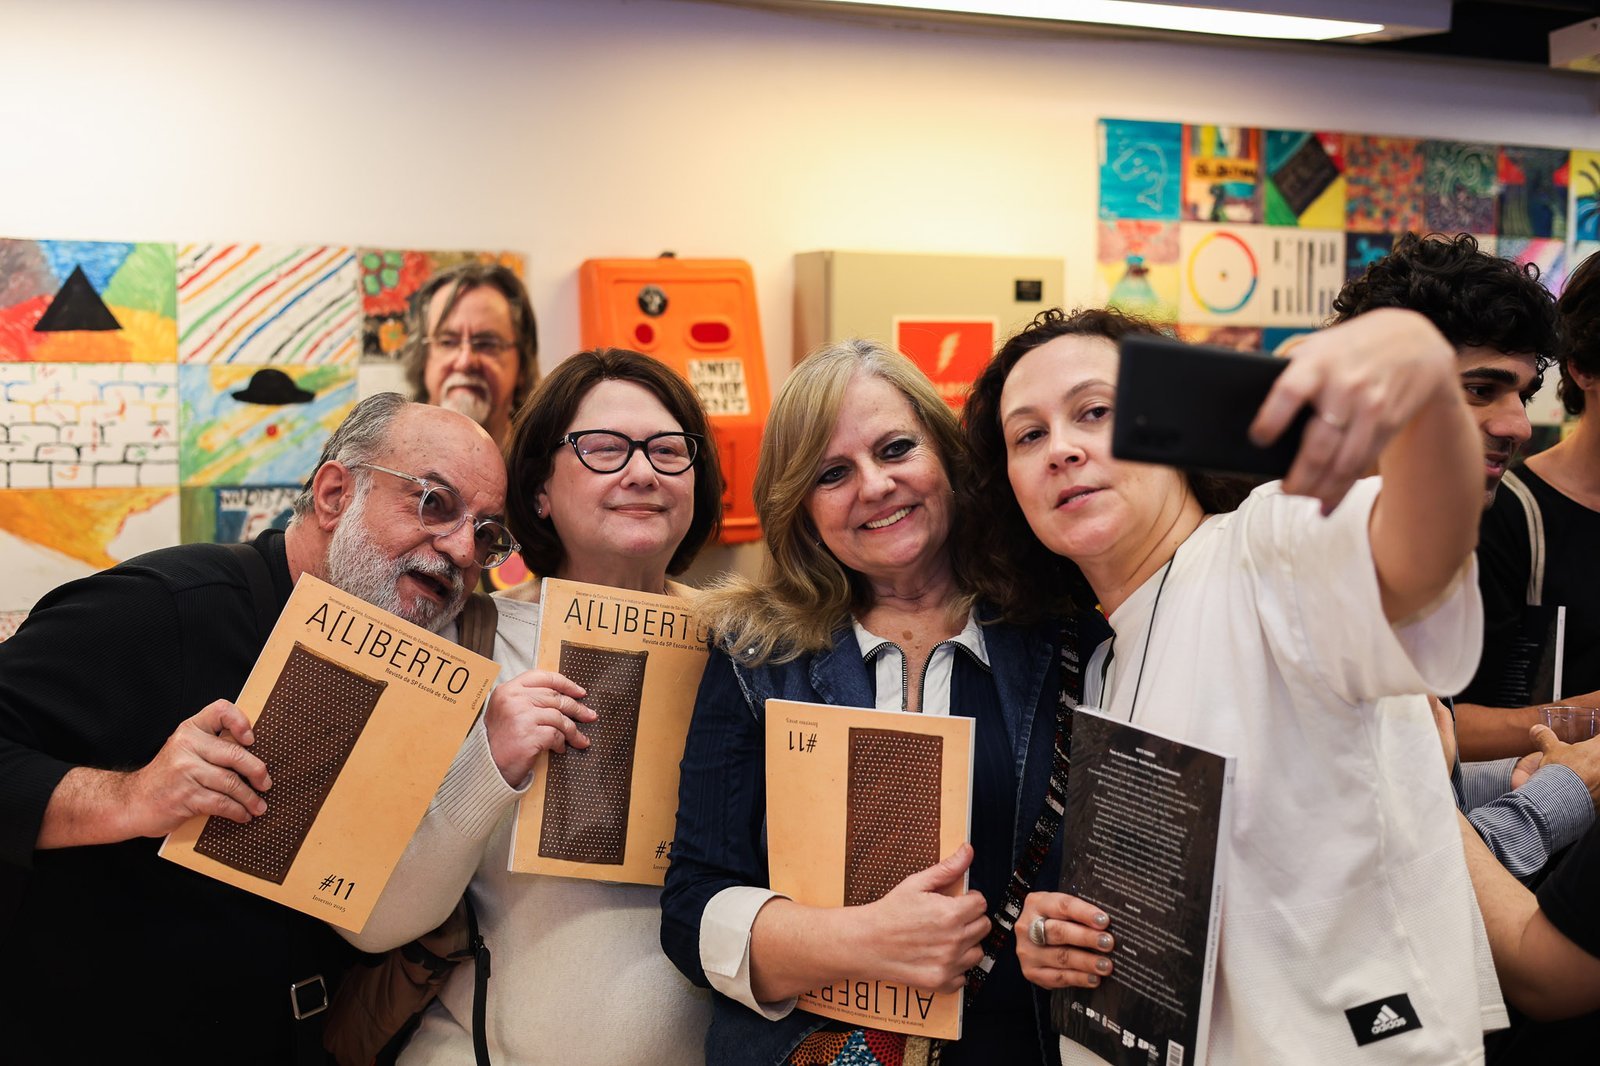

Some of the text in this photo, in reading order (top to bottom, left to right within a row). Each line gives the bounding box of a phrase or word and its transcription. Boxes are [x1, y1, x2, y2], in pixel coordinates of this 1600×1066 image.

[305, 602, 470, 694] A[L]BERTO
[643, 637, 659, 646] Revista
[673, 642, 687, 650] Escola
[384, 666, 403, 679] Revista
[403, 675, 410, 683] da
[409, 678, 418, 686] SP
[417, 682, 434, 694] Escola
[440, 693, 457, 705] Teatro
[789, 731, 817, 753] #11
[318, 874, 355, 900] #11
